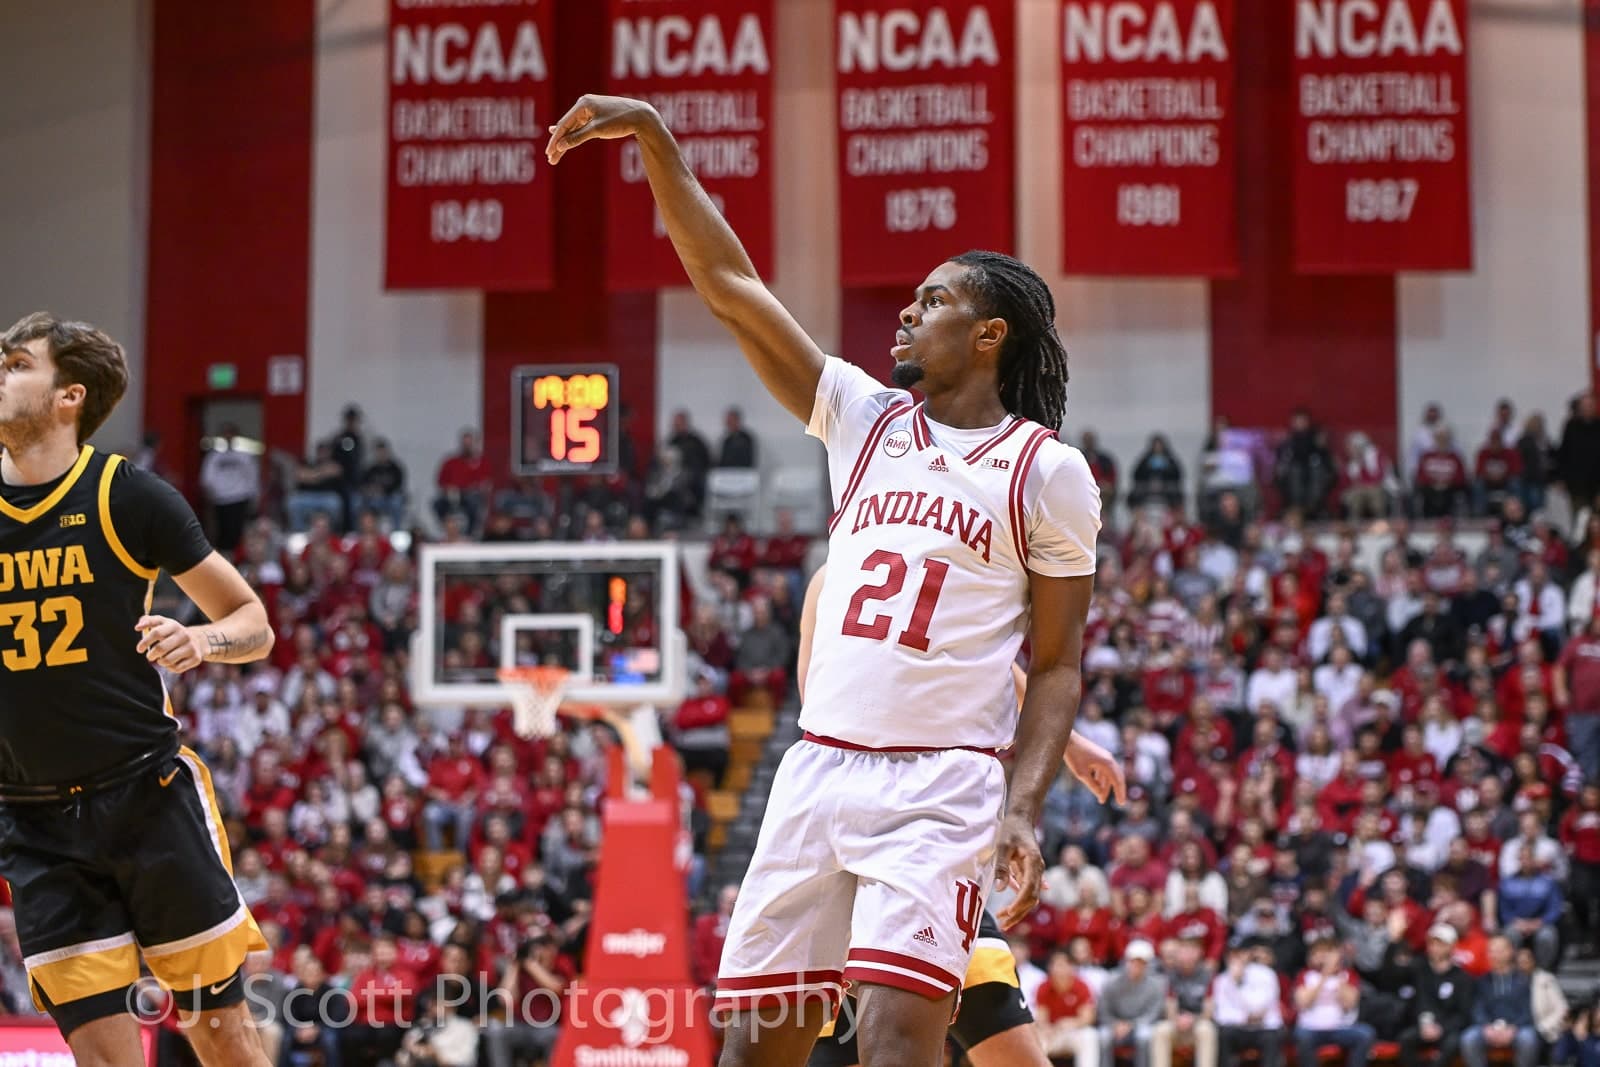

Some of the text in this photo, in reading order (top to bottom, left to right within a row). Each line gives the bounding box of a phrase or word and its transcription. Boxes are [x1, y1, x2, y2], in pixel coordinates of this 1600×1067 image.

[611, 14, 769, 79] NCAA
[838, 7, 998, 72] NCAA
[1064, 1, 1228, 63] NCAA
[1295, 0, 1463, 58] NCAA
[393, 21, 547, 84] NCAA
[841, 84, 994, 130] BASKETBALL
[1067, 78, 1223, 120] BASKETBALL
[1300, 72, 1460, 116] BASKETBALL
[394, 98, 540, 141] BASKETBALL
[1307, 119, 1454, 163] CHAMPIONS
[398, 142, 535, 186] CHAMPIONS
[847, 129, 988, 176] CHAMPIONS
[1073, 124, 1219, 167] CHAMPIONS
[430, 199, 504, 242] 1940
[885, 187, 956, 232] 1976
[1116, 184, 1180, 226] 1981
[1346, 179, 1418, 222] 1987
[551, 407, 600, 463] 15
[885, 437, 909, 450] RMK
[928, 464, 949, 472] adidas
[851, 491, 993, 564] INDIANA
[841, 549, 950, 652] 21
[0, 595, 88, 672] 32
[912, 934, 938, 947] adidas
[574, 1045, 689, 1067] Smithville
